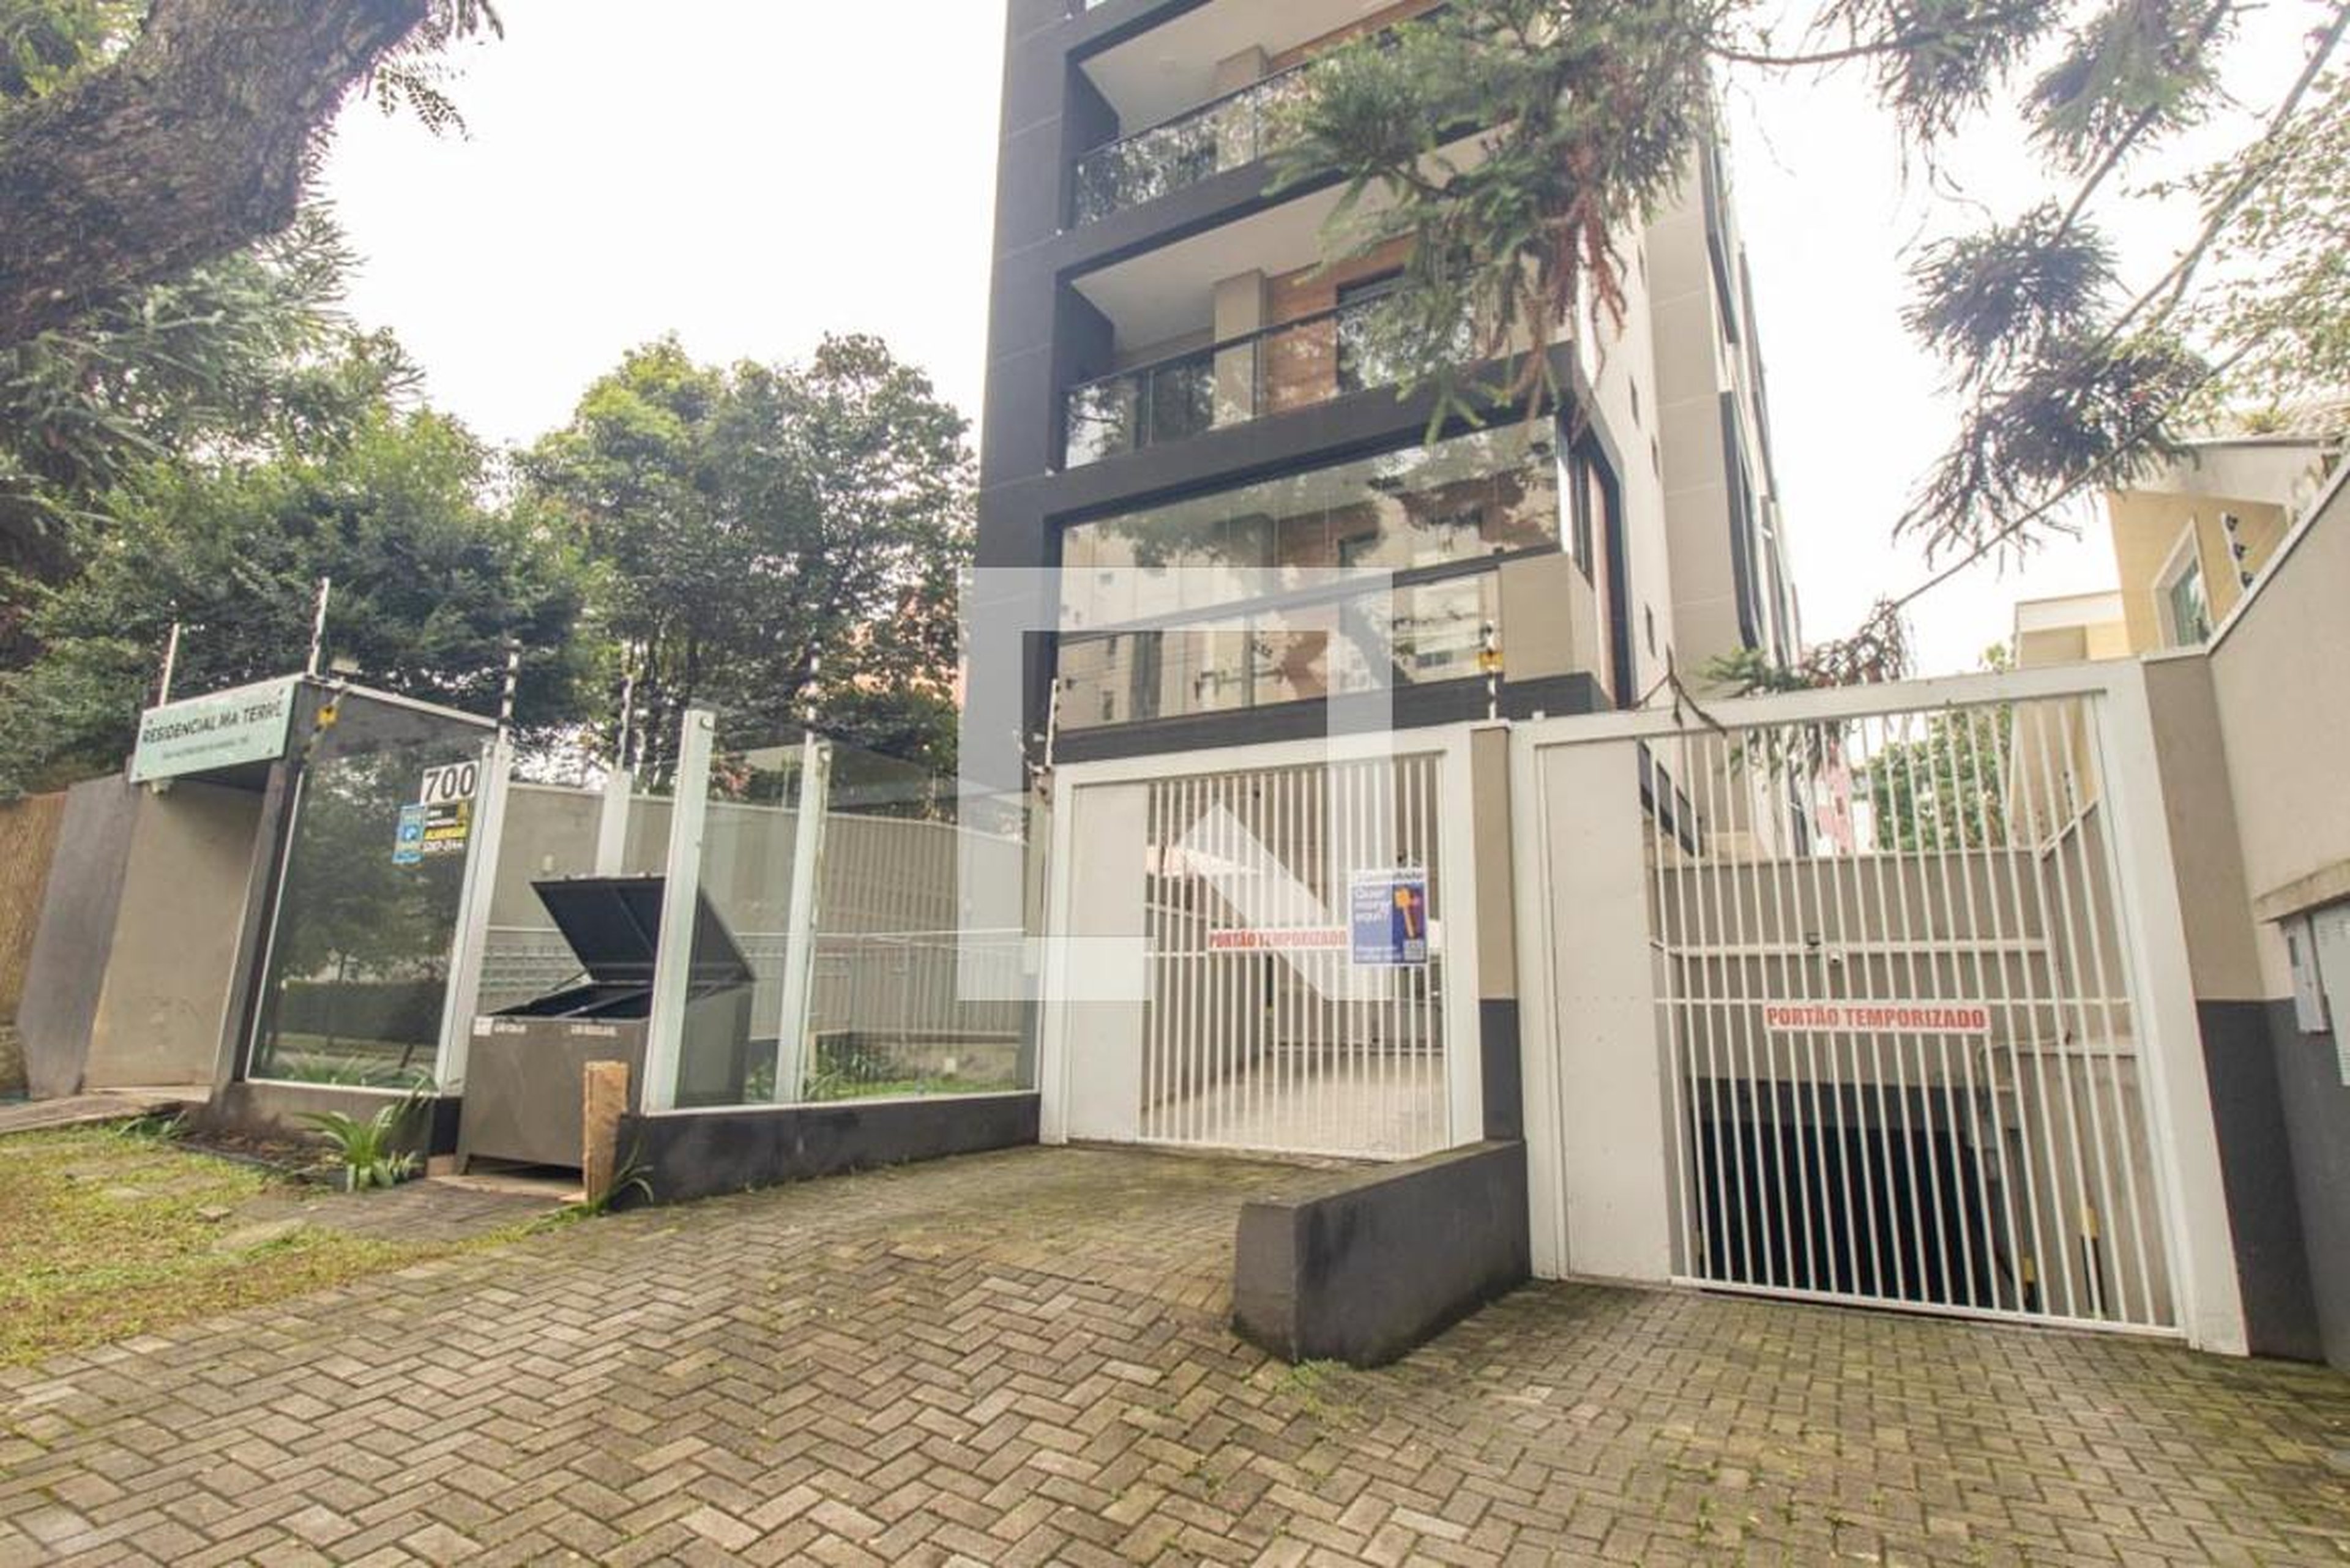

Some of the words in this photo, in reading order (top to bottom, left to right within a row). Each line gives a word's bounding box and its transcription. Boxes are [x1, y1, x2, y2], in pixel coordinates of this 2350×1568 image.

[141, 715, 215, 744] RESIDENCIAL
[425, 764, 476, 802] 700
[1767, 1006, 1838, 1028] PORTÃO
[1845, 1007, 1986, 1028] TEMPORIZADO
